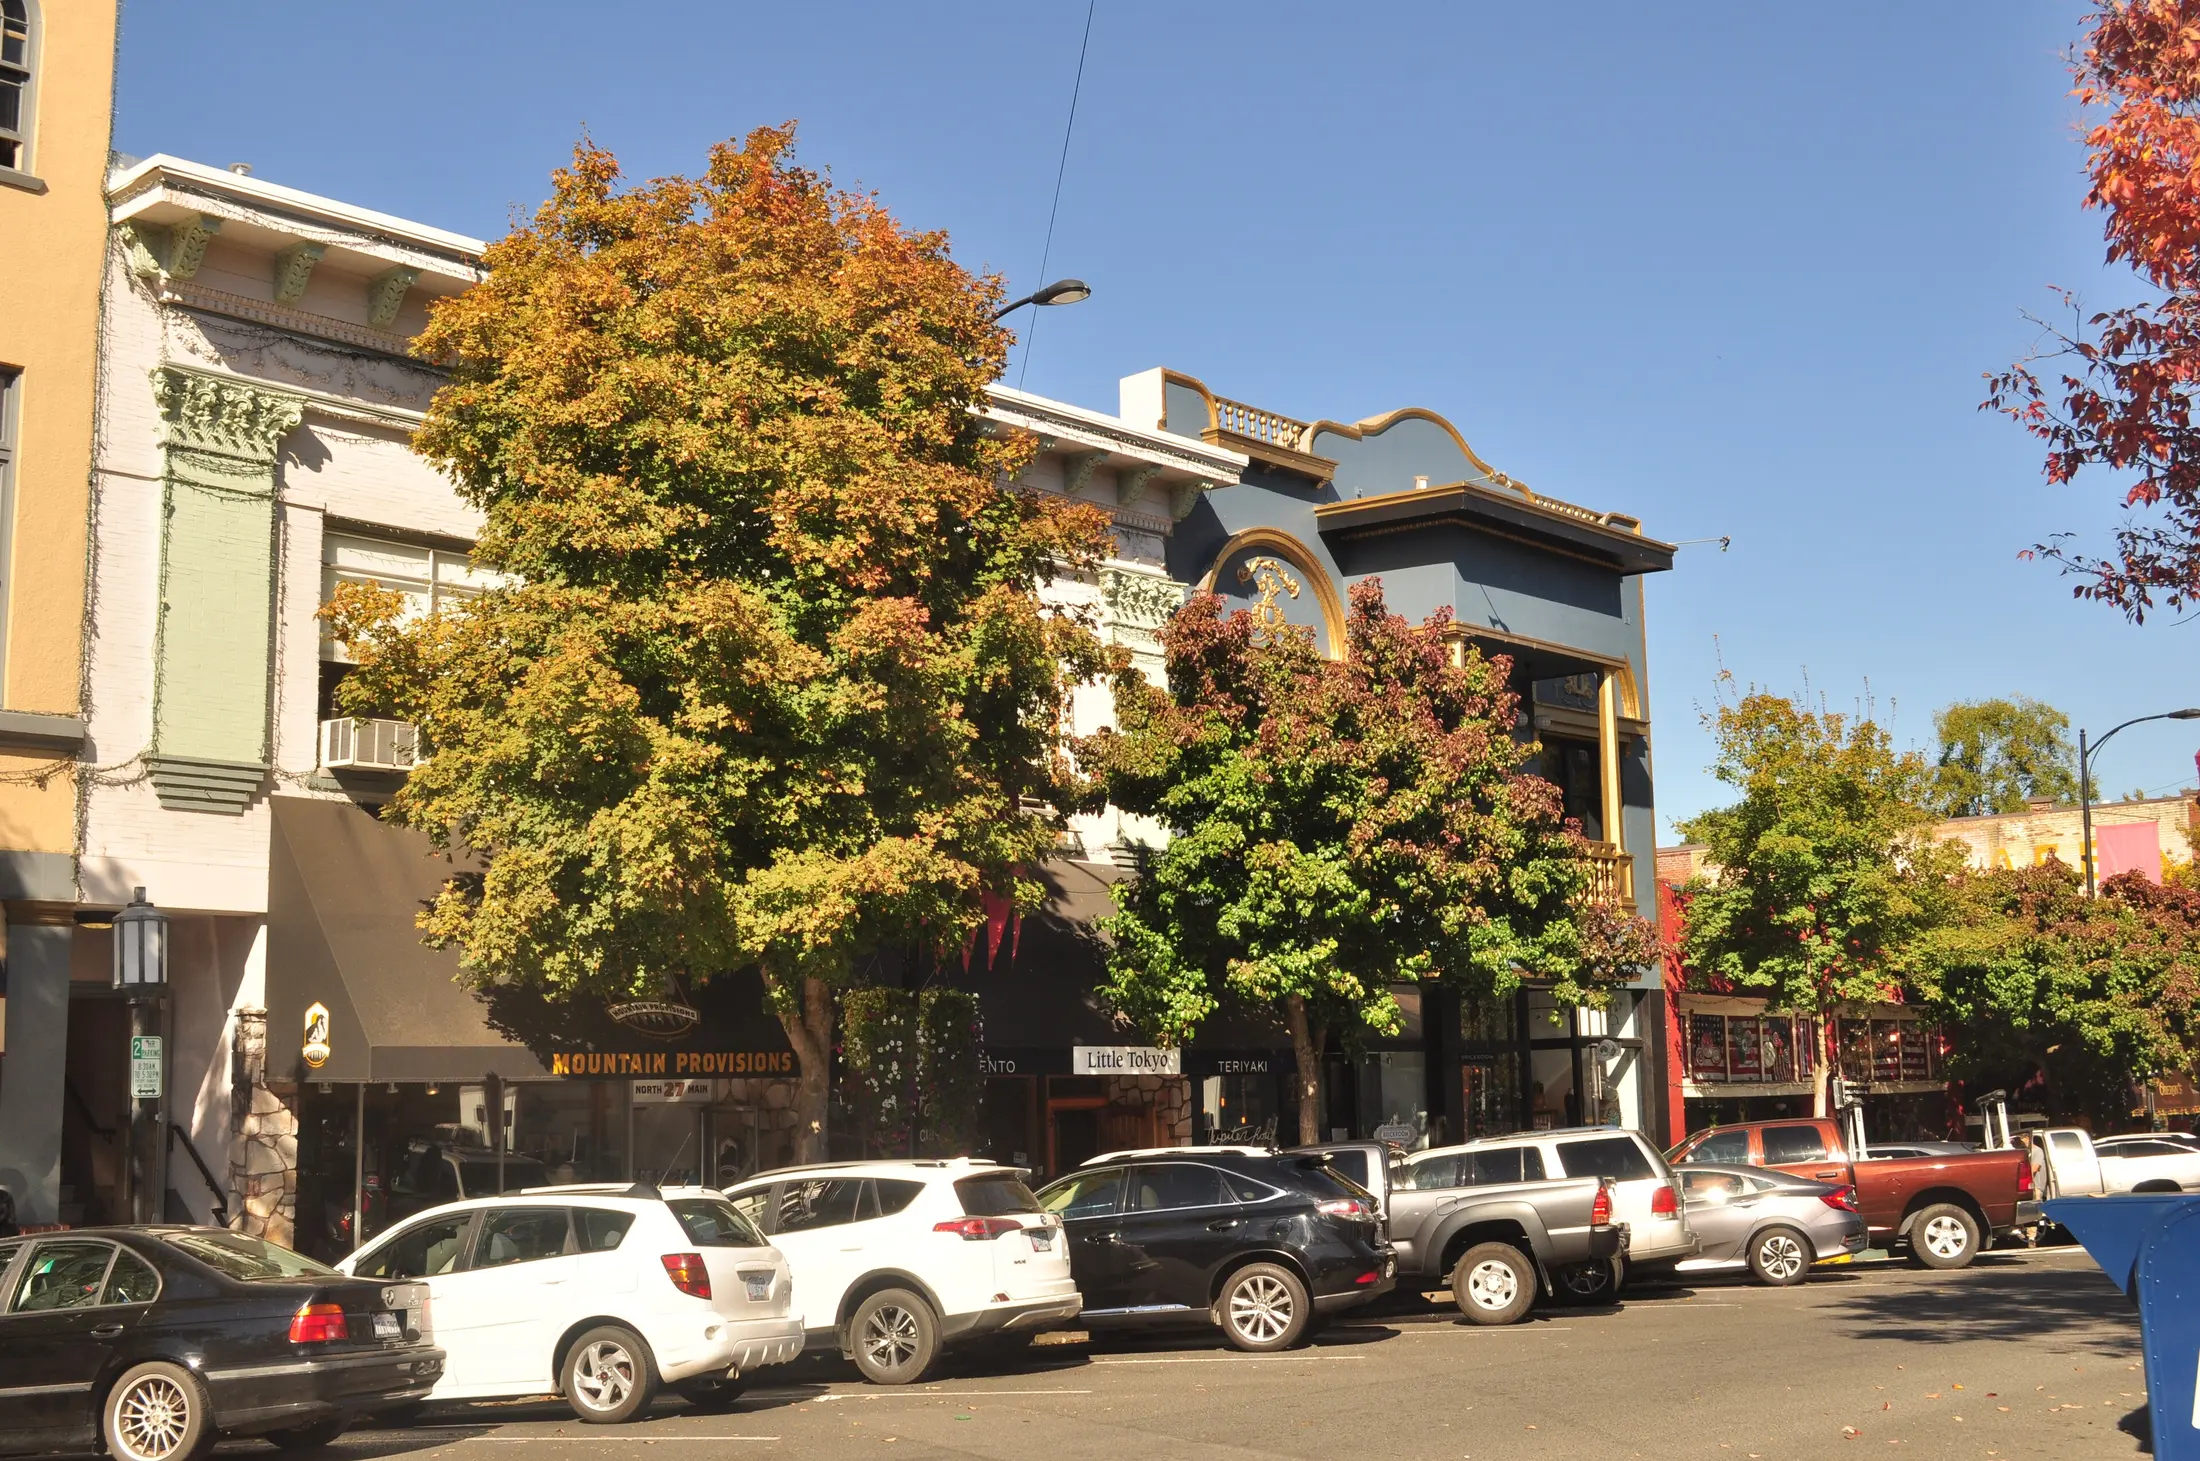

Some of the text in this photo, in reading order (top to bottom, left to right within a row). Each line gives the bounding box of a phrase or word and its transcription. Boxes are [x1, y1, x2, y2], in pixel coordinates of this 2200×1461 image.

[612, 1003, 696, 1018] MOUNTAIN PROVISIONS
[133, 1041, 141, 1056] 2
[552, 1052, 792, 1075] MOUNTAIN PROVISIONS
[979, 1060, 1016, 1073] ENTO
[1087, 1051, 1168, 1072] Little Tokyo
[1218, 1060, 1268, 1073] TERIYAKI
[635, 1082, 708, 1097] NORTH 27 MAIN
